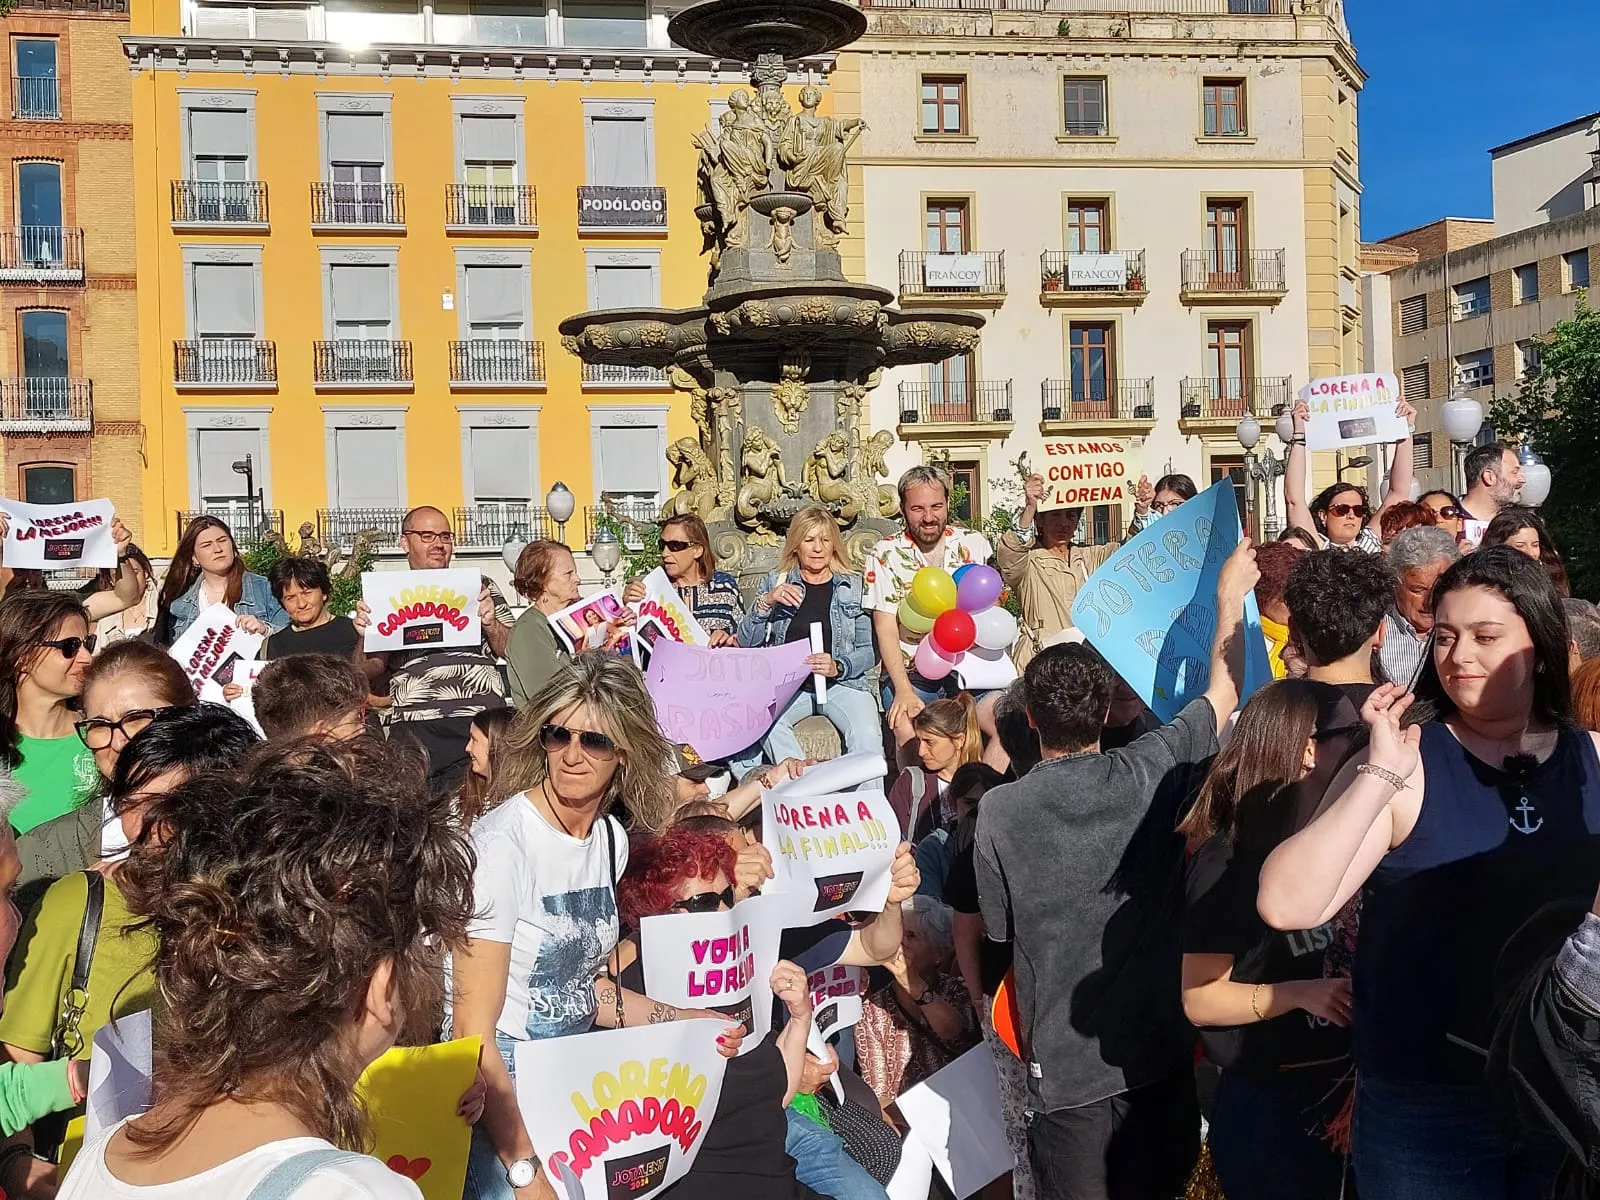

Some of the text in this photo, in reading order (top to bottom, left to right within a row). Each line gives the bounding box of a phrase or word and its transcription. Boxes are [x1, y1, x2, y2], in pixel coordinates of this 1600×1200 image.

[583, 197, 662, 211] PODÓLOGO
[1311, 377, 1385, 396] LORENA A
[1311, 400, 1329, 412] LA
[1045, 442, 1124, 455] ESTAMOS
[1048, 461, 1125, 481] CONTIGO
[1056, 486, 1123, 504] LORENA
[16, 527, 36, 541] LA
[1077, 516, 1219, 638] JOTERA
[389, 585, 469, 610] LORENA
[377, 602, 470, 636] GANADORA
[186, 627, 218, 675] LORENA
[685, 649, 772, 683] JOTA
[773, 800, 873, 831] LORENA A
[778, 818, 888, 861] LA FINAL!!!
[571, 1057, 708, 1125] LORENA
[548, 1096, 702, 1181] GANADORA
[612, 1157, 666, 1186] JOTALENT
[630, 1177, 649, 1191] 2024
